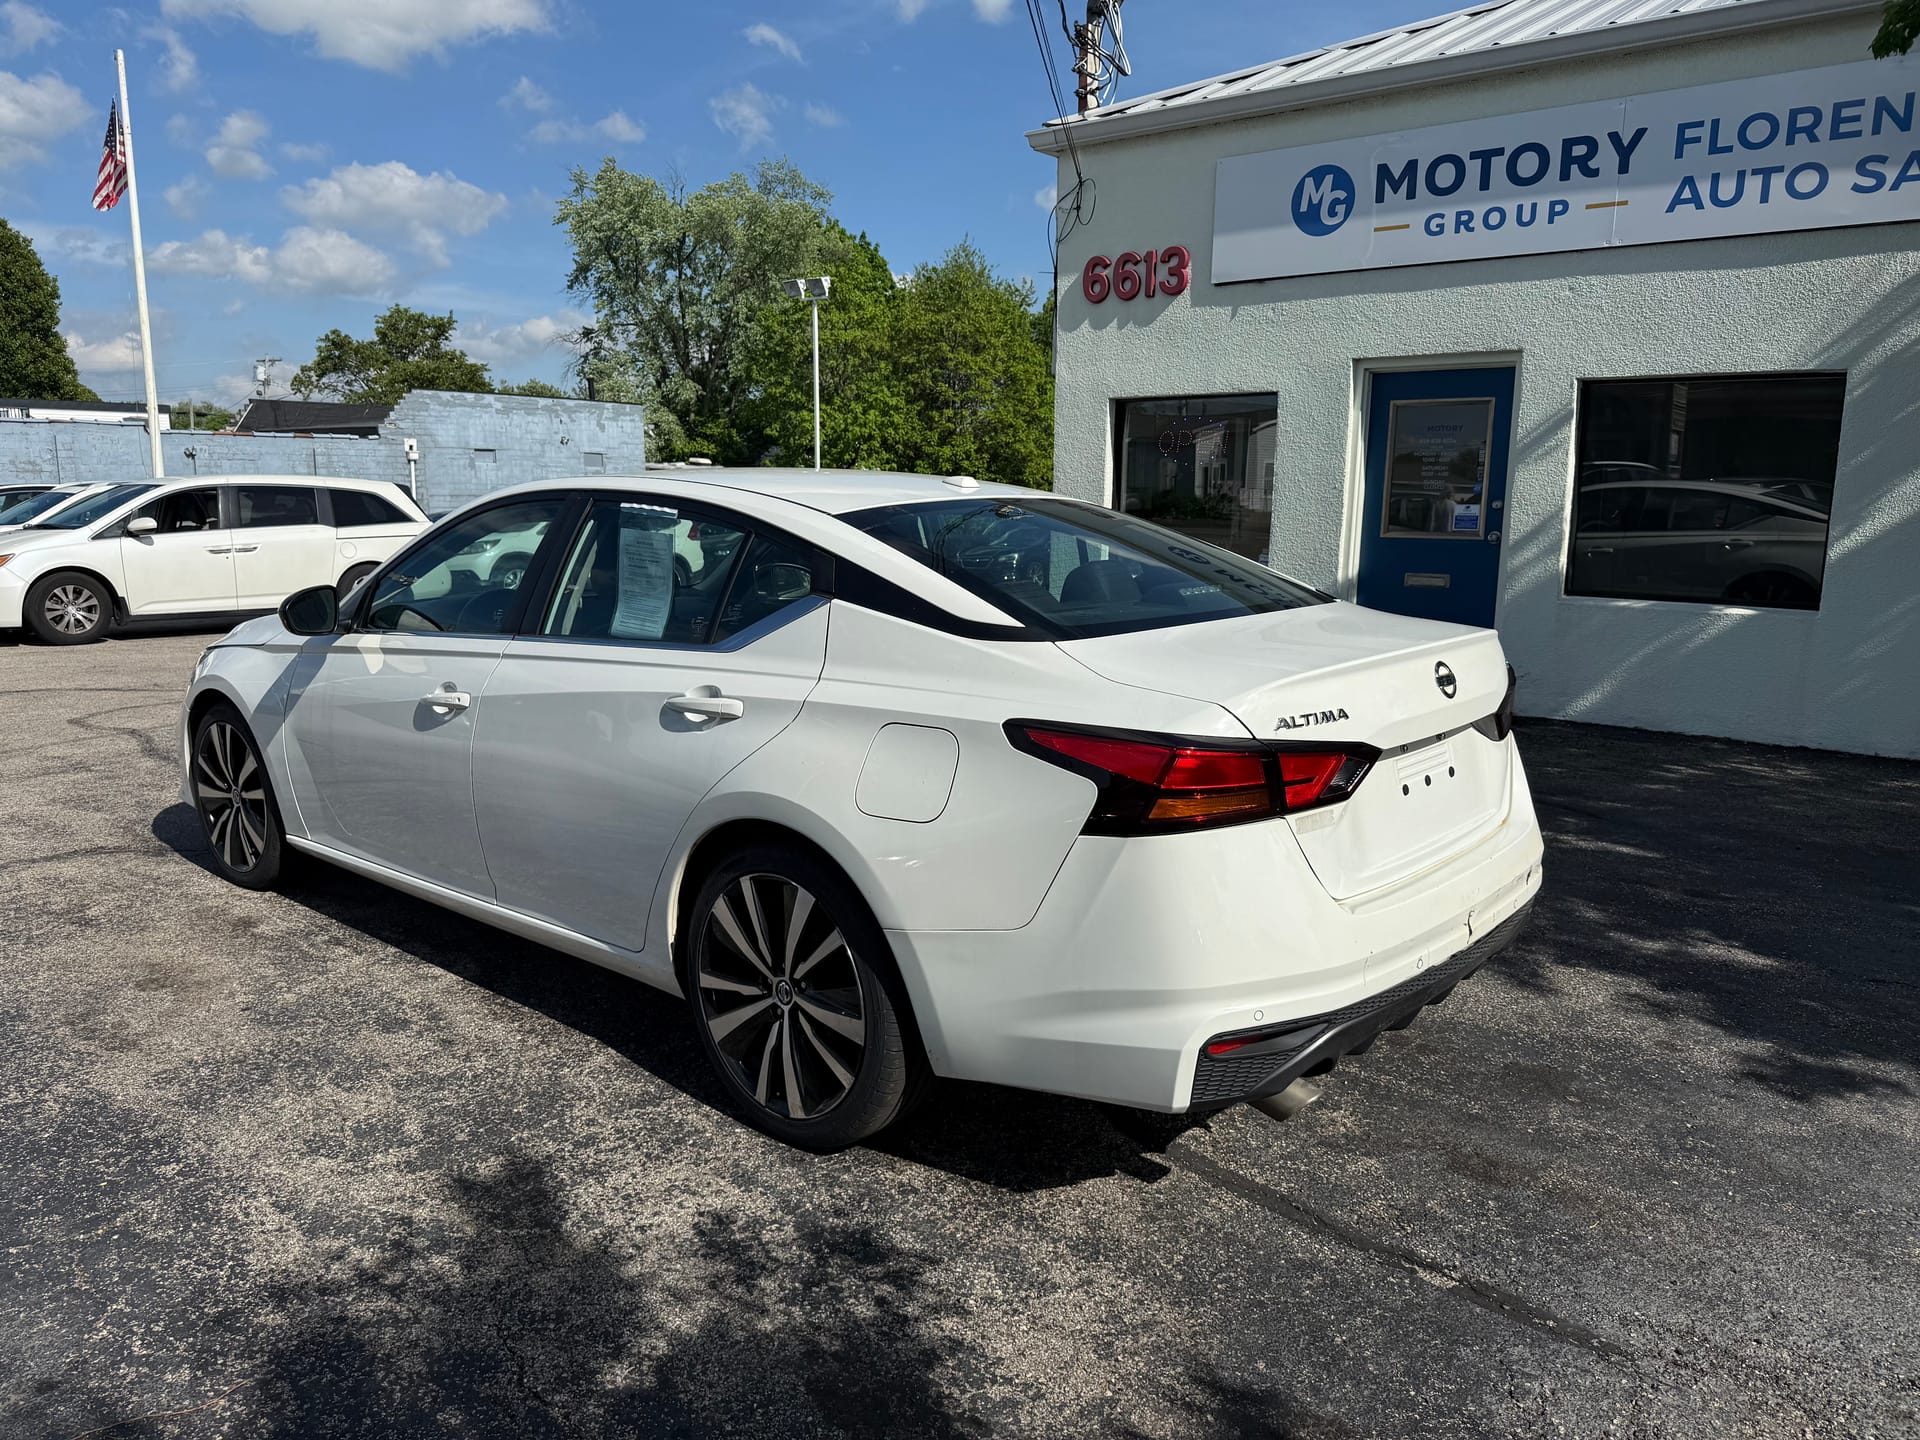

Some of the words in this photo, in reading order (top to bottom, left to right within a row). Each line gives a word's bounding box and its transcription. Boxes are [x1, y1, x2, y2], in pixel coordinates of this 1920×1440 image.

[1375, 127, 1649, 204] MOTORY
[1665, 161, 1830, 214] AUTO
[1299, 173, 1349, 227] MG
[1423, 199, 1570, 237] GROUP
[1083, 246, 1191, 304] 6613
[1273, 708, 1350, 732] ALTIMA
